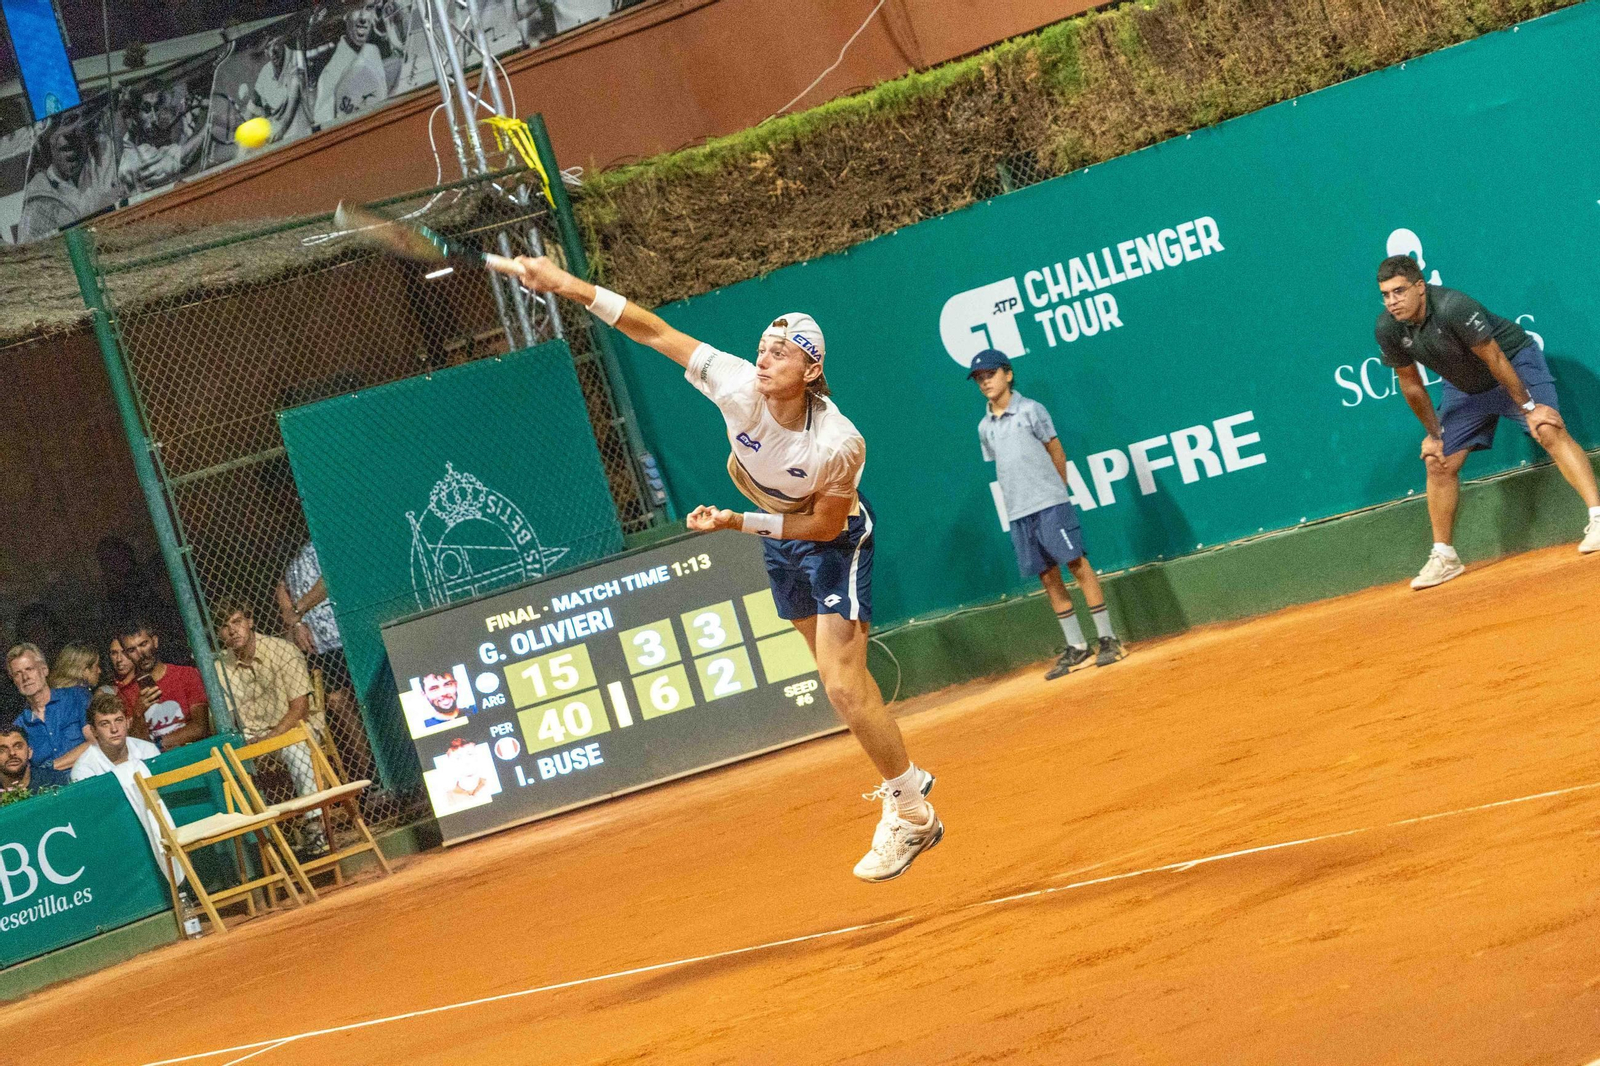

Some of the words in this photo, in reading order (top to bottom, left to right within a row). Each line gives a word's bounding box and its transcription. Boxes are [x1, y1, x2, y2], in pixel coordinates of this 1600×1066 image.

[1023, 216, 1225, 308] CHALLENGER
[992, 296, 1018, 316] ATP
[1034, 292, 1124, 348] TOUR
[792, 333, 822, 363] ETNA
[486, 495, 532, 545] BETIS
[485, 605, 541, 633] FINAL
[551, 580, 621, 614] MATCH
[621, 565, 671, 593] TIME
[671, 553, 712, 578] 1:13
[478, 641, 508, 665] G.
[510, 606, 615, 656] OLIVIERI
[521, 653, 580, 698] 15
[632, 629, 666, 667] 3
[693, 611, 726, 649] 3
[481, 693, 507, 710] ARG
[537, 701, 593, 744] 40
[649, 674, 680, 712] 6
[707, 657, 742, 697] 2
[783, 679, 818, 698] SEED
[489, 721, 514, 739] PER
[514, 765, 535, 787] I.
[537, 742, 605, 780] BUSE
